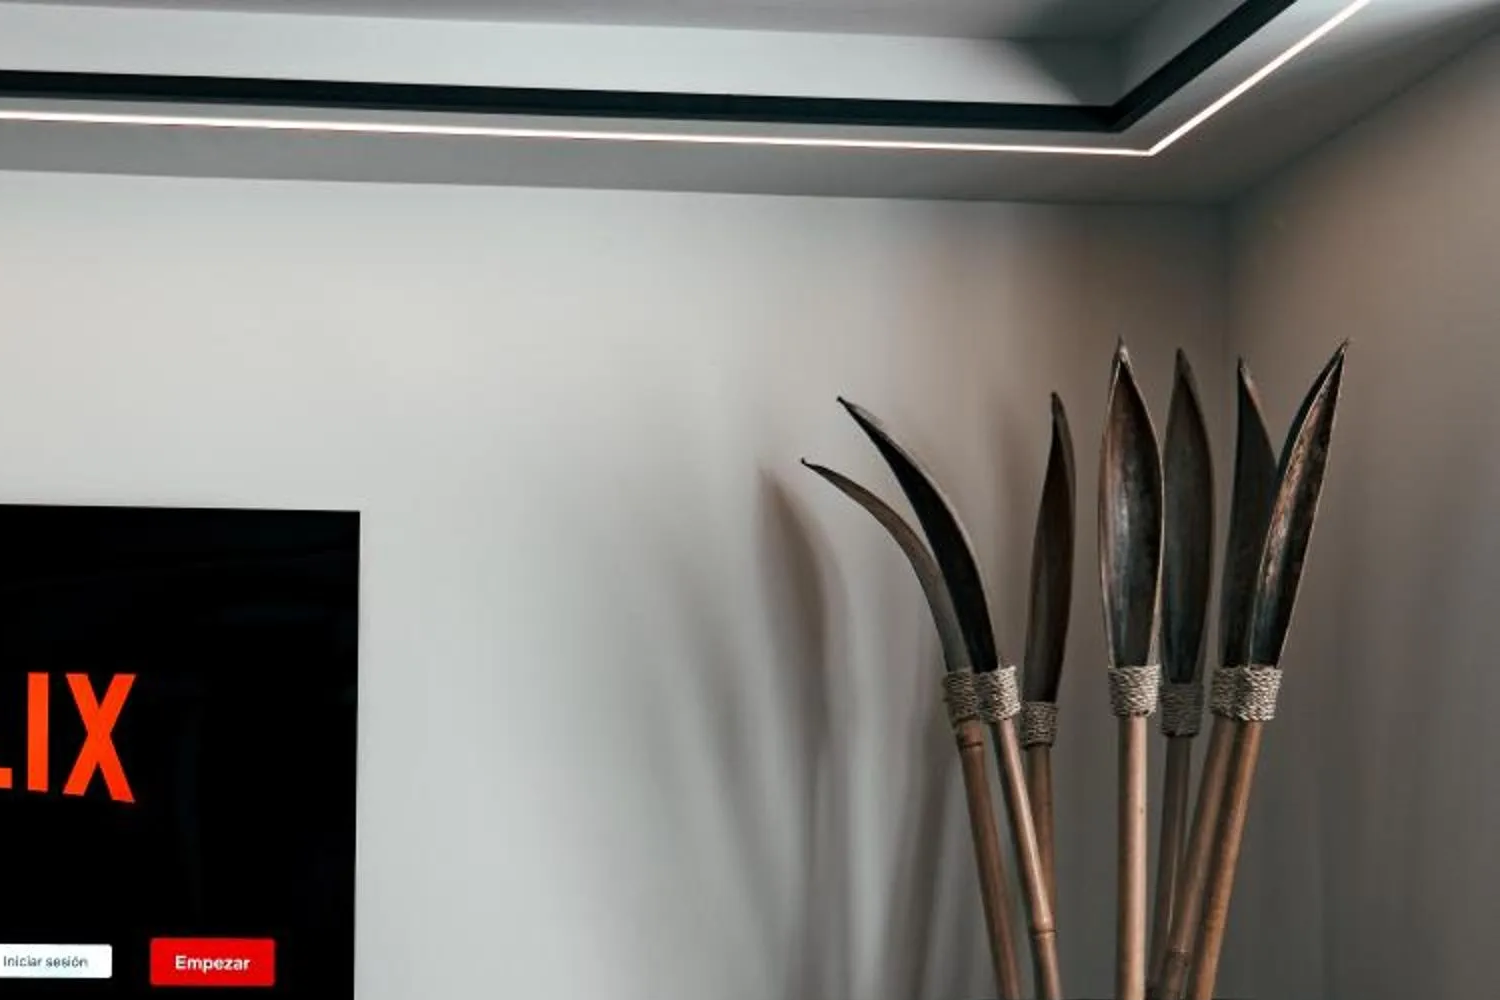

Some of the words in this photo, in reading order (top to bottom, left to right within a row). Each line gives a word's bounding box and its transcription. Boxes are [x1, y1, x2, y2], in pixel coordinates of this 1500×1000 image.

[2, 955, 42, 968] Iniciar
[45, 955, 89, 969] sesión
[175, 954, 250, 974] Empezar
